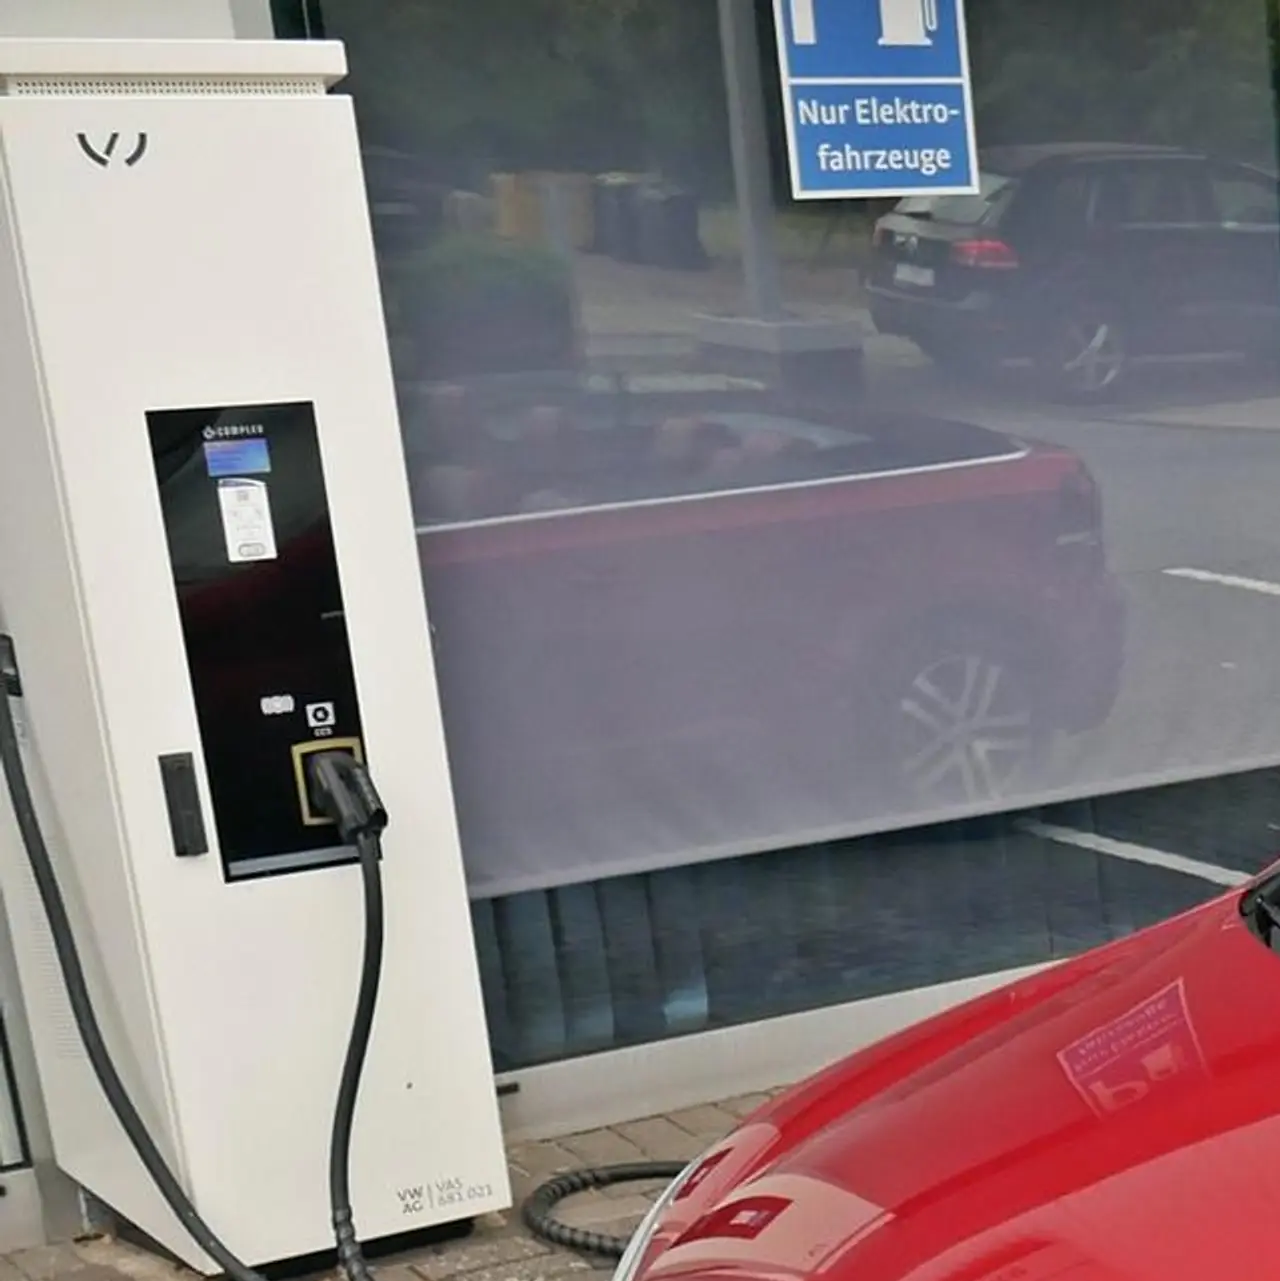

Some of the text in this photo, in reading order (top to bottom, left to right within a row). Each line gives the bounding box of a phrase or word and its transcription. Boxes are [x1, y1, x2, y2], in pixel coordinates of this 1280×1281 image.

[797, 97, 961, 125] Nur Elektro-
[817, 144, 951, 176] fahrzeuge
